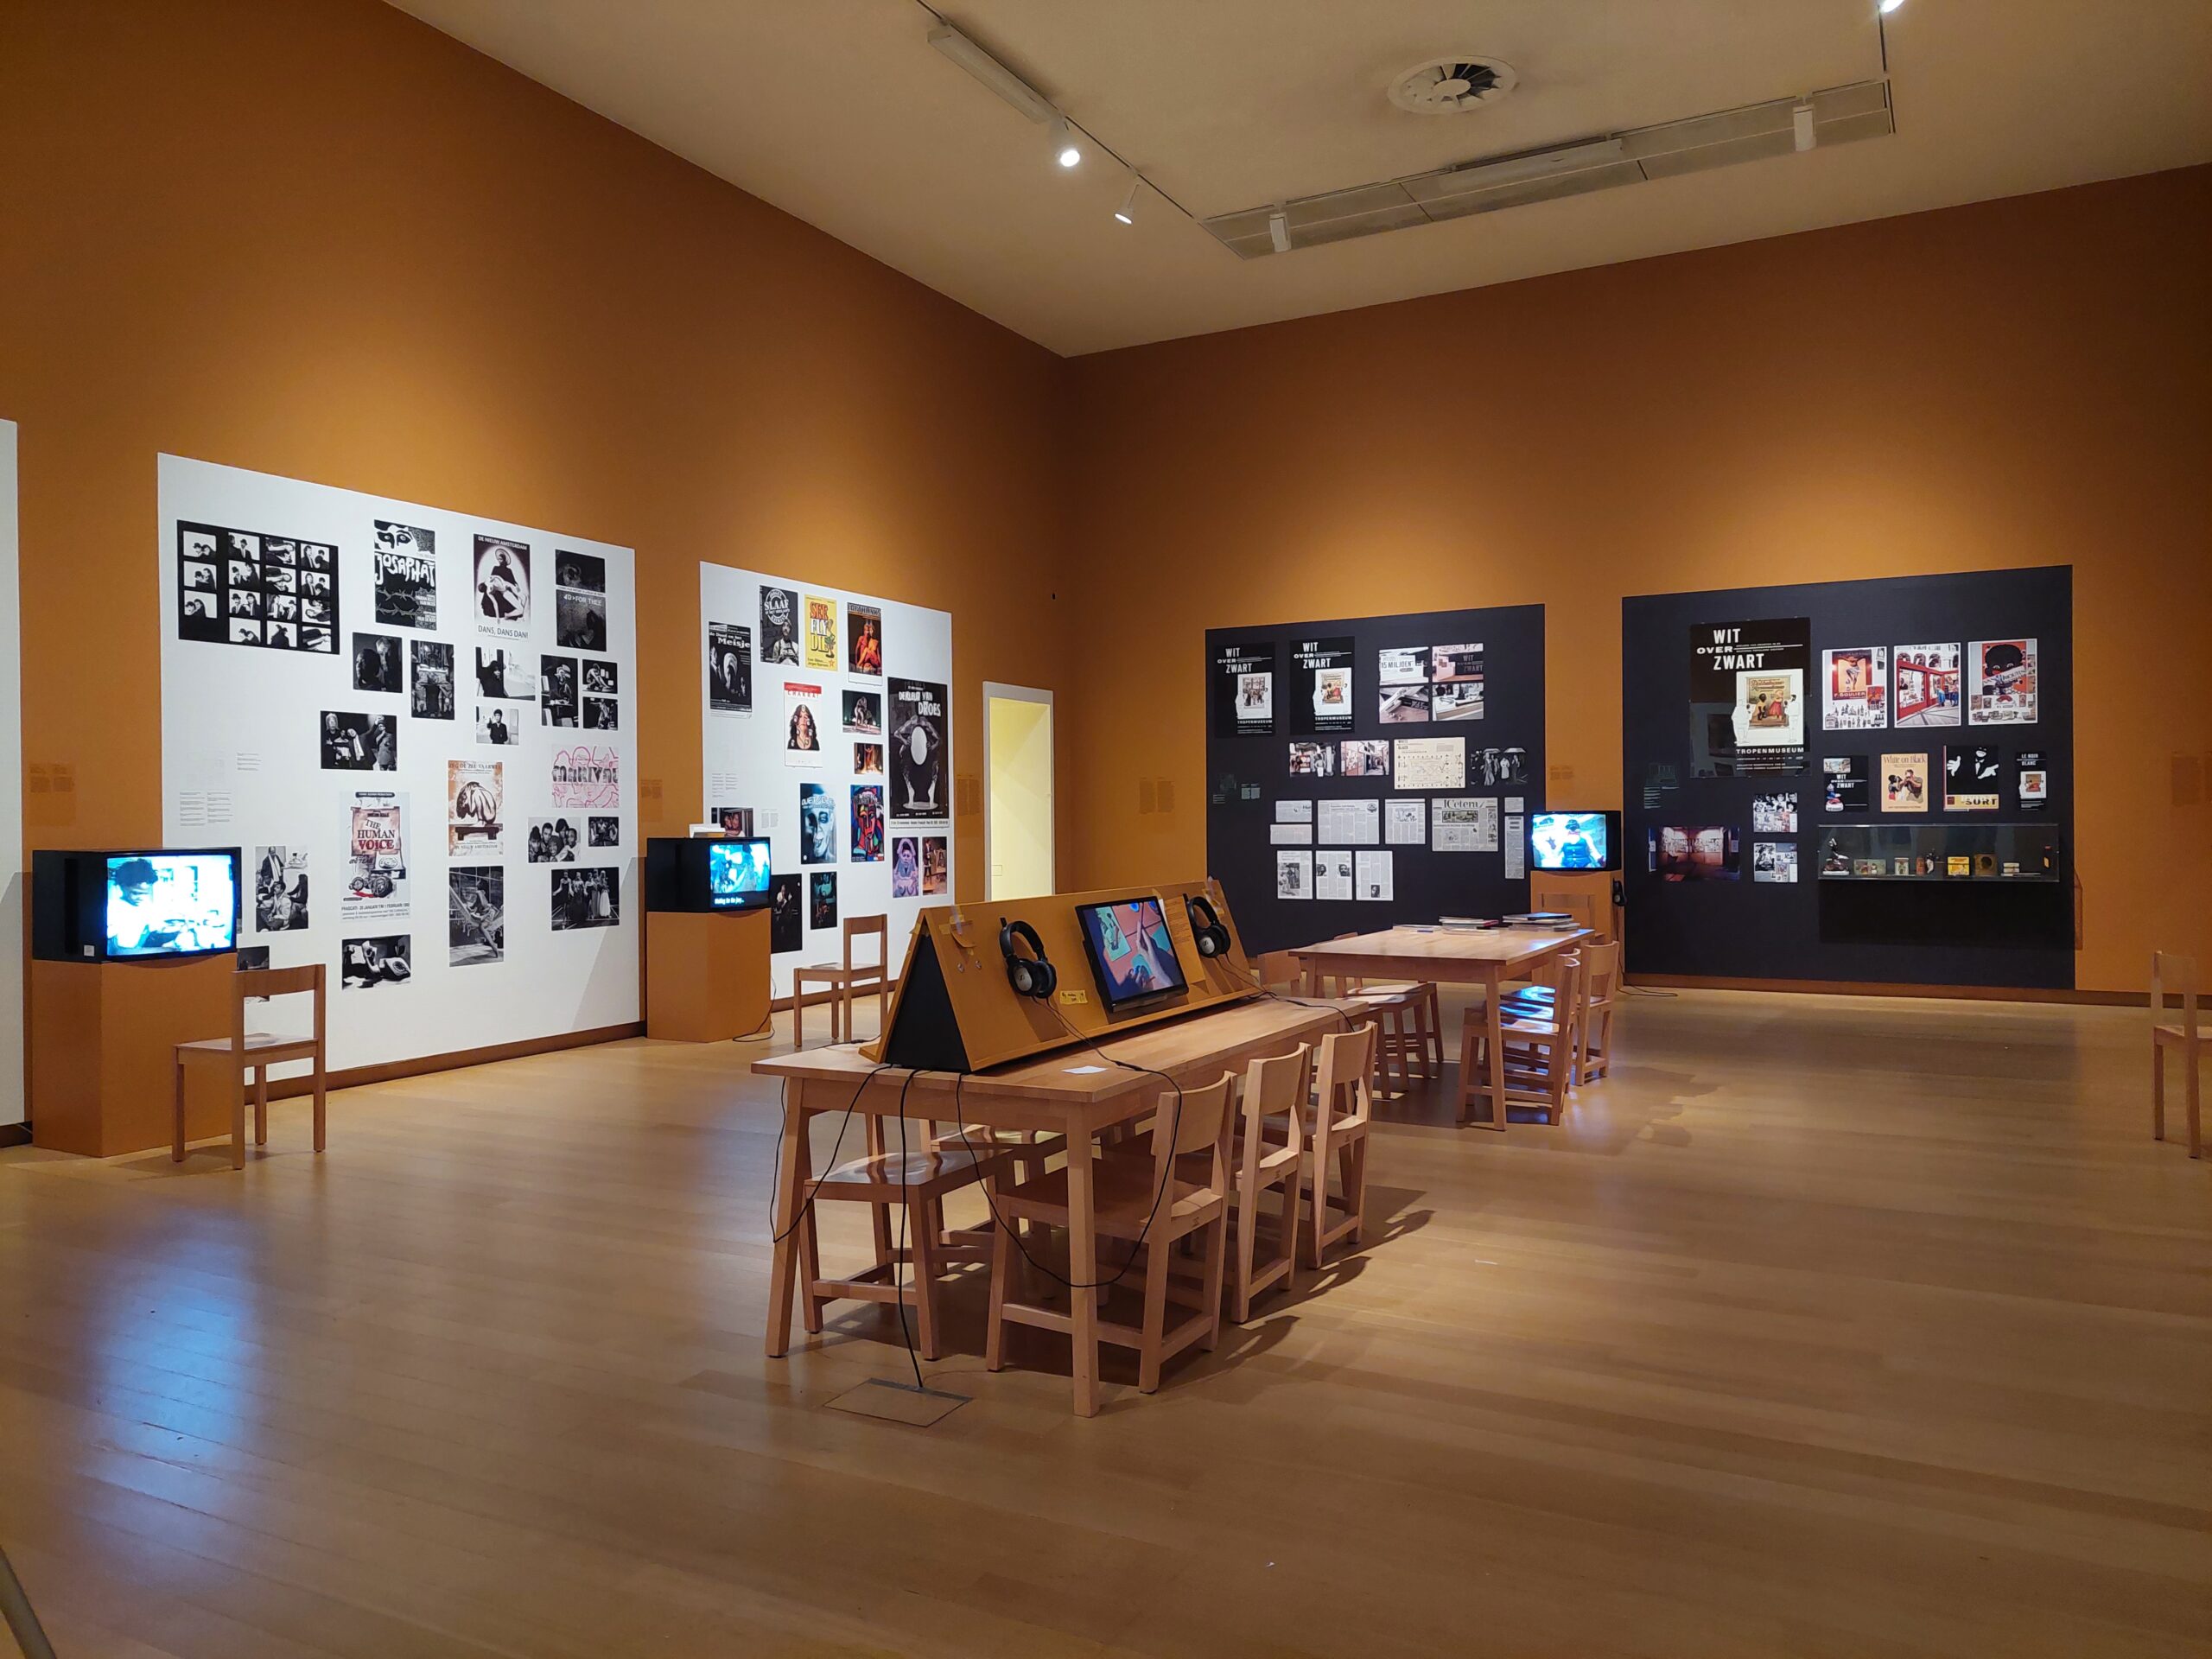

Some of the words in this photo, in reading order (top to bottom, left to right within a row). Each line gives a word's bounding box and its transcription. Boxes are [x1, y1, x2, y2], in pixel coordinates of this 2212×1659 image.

[374, 553, 435, 588] JOSAPHAT
[764, 599, 789, 611] SLAAF
[810, 601, 829, 620] SEE
[478, 625, 496, 636] DANS,
[497, 627, 513, 637] DANS
[810, 618, 828, 636] FLY
[1713, 628, 1741, 644] WIT
[717, 637, 751, 649] Meisje
[1302, 642, 1319, 652] WIT
[1225, 647, 1240, 658] WIT
[1696, 645, 1733, 654] OVER
[1303, 658, 1331, 669] ZWART
[1713, 653, 1764, 671] ZWART
[1225, 663, 1253, 674] ZWART
[918, 701, 941, 716] DROES
[1884, 754, 1899, 764] White
[1910, 754, 1926, 764] Black
[365, 819, 381, 830] THE
[358, 830, 396, 839] HUMAN
[358, 839, 395, 850] VOICE
